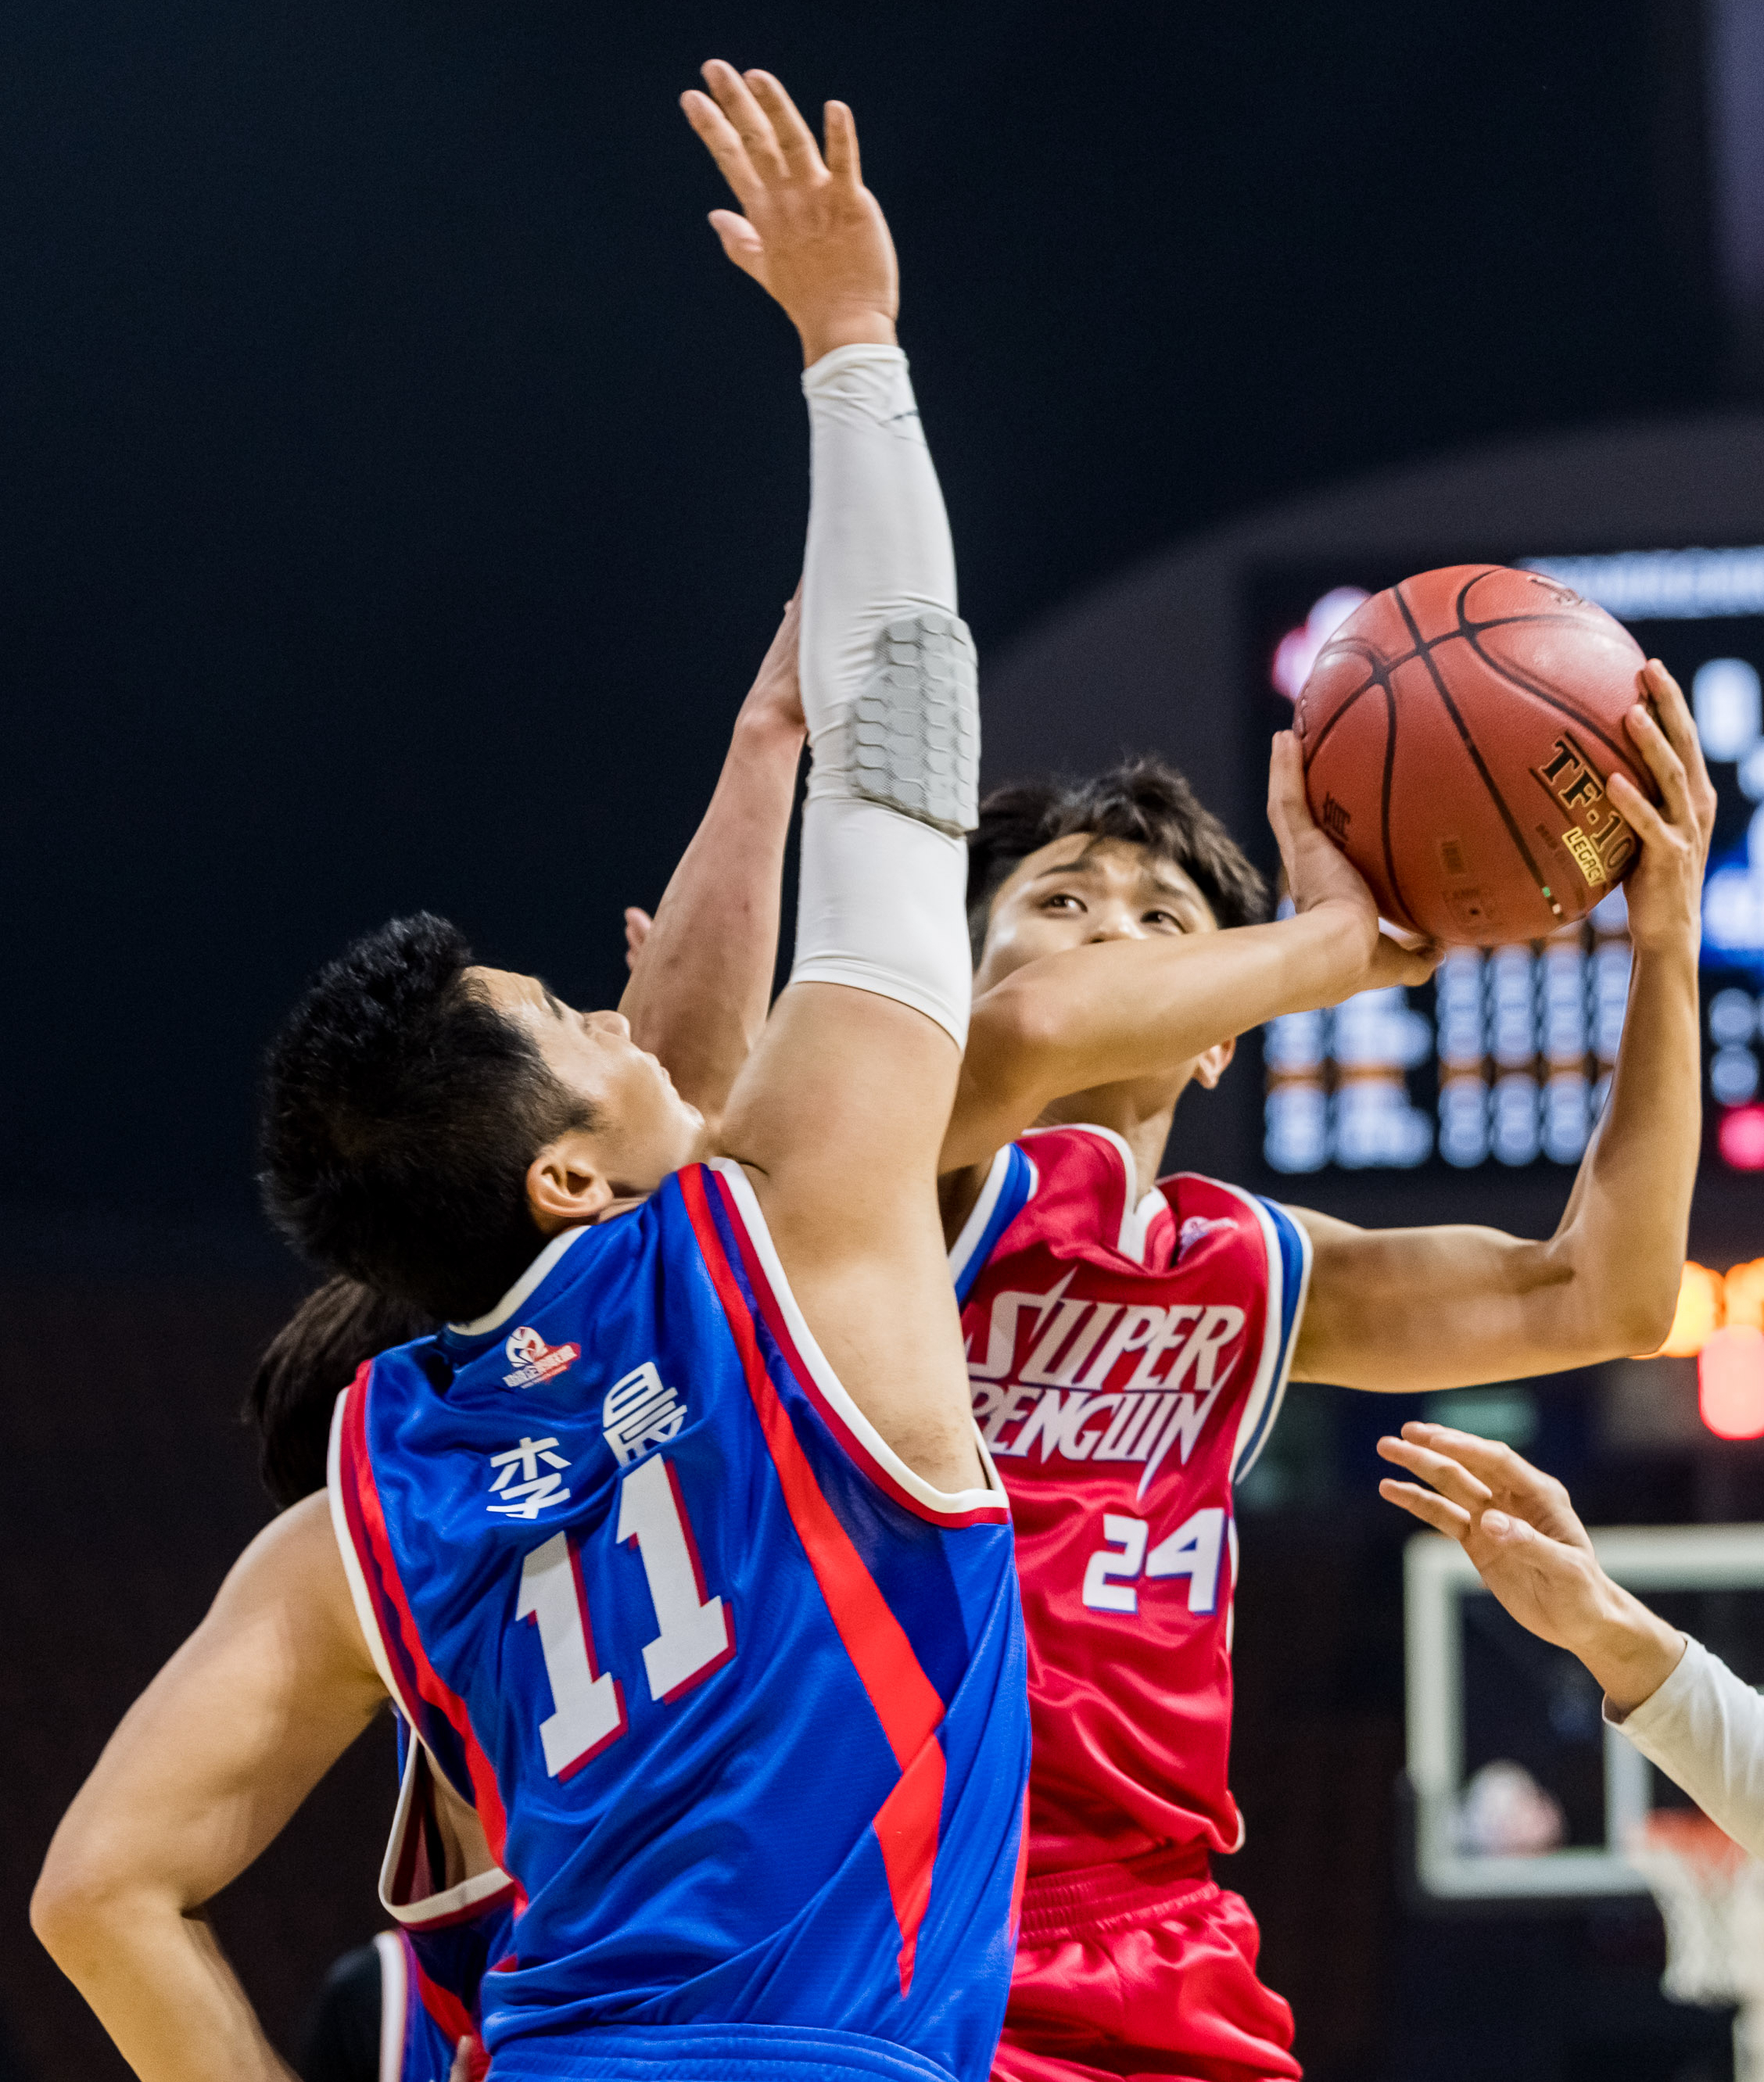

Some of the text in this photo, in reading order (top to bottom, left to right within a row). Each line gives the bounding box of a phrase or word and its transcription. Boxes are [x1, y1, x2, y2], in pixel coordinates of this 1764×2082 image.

[1563, 827, 1606, 886] LEGACY
[966, 1267, 1246, 1391] SUPER
[970, 1368, 1234, 1500] PENGUIN
[516, 1453, 733, 1779] 11
[1082, 1507, 1225, 1614] 24
